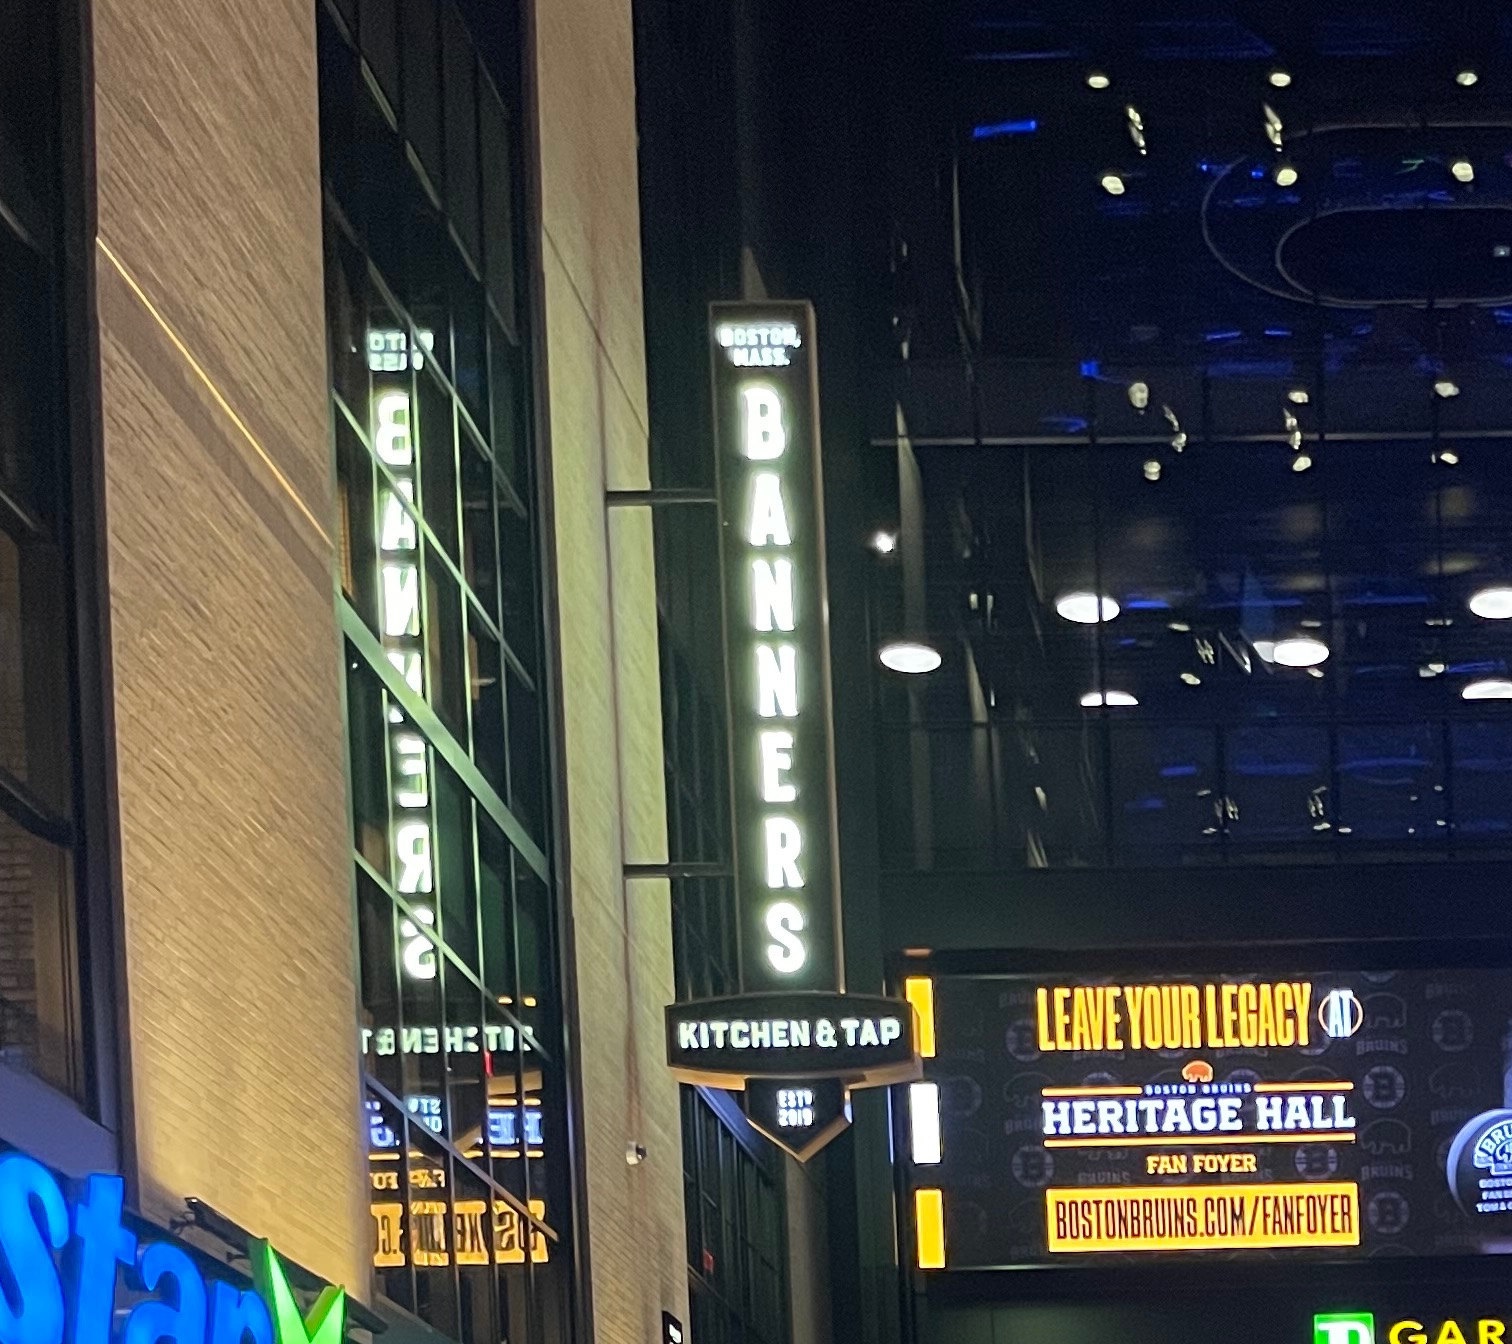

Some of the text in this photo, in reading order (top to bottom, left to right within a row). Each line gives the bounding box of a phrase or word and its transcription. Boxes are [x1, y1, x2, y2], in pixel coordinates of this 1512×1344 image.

[733, 347, 790, 366] MASS.
[743, 387, 806, 973] BANNERS
[679, 1018, 901, 1050] KITCHEN & TAP
[1036, 982, 1355, 1051] LEAVE YOUR LEGACY AT
[1143, 1082, 1252, 1096] BOSTON BRUINS
[1042, 1095, 1355, 1135] HERITAGE HALL
[1147, 1153, 1257, 1175] FAN FOYER
[1055, 1193, 1353, 1240] BOSTONBRUINS.COM/FANFOYER
